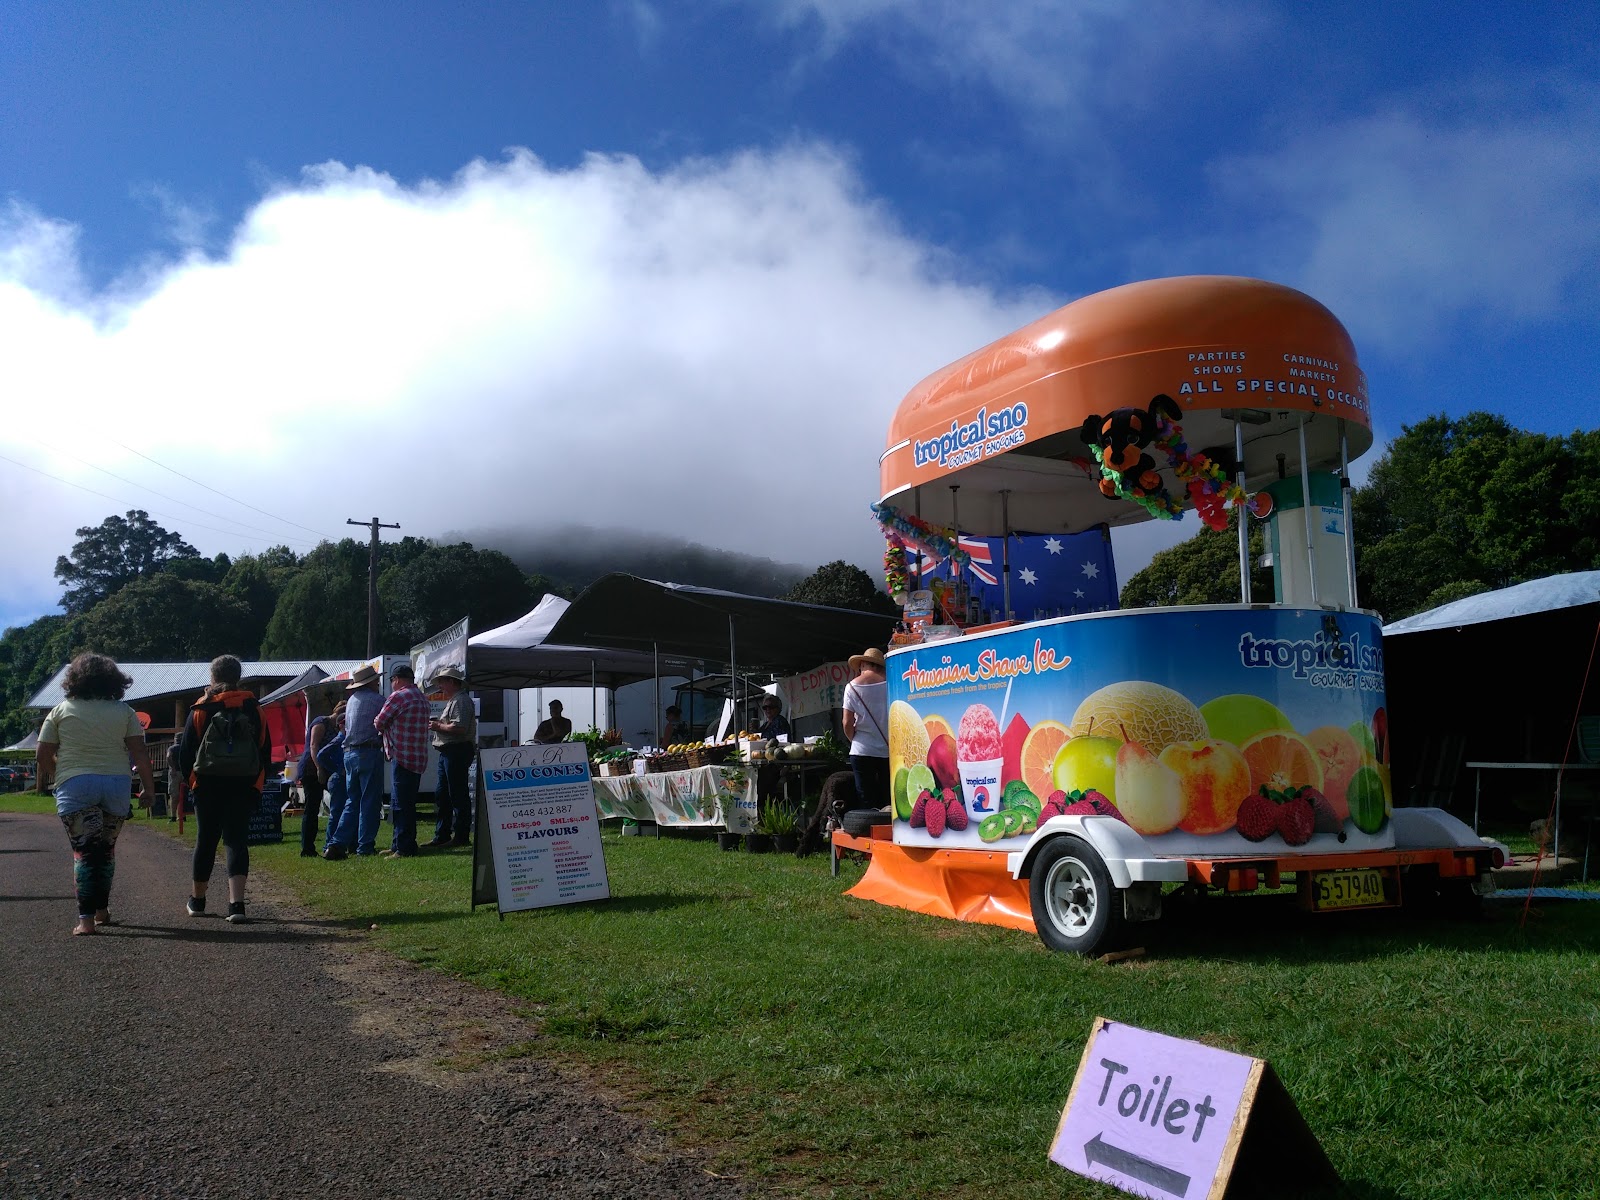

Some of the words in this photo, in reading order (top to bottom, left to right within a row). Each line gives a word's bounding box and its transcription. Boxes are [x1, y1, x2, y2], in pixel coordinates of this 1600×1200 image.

[1188, 351, 1246, 362] PARTIES
[1283, 353, 1339, 371] CARNIVALS
[1193, 365, 1243, 375] SHOWS
[1289, 367, 1336, 384] MARKETS
[1179, 380, 1223, 394] ALL
[1236, 380, 1319, 397] SPECIAL
[914, 406, 987, 467] tropical
[987, 401, 1028, 438] sno
[948, 445, 983, 469] GOURMET
[985, 429, 1025, 456] SNOCONES
[1239, 632, 1360, 679] tropical
[902, 655, 978, 692] Hawaiian
[978, 649, 1032, 680] Shave
[1033, 638, 1072, 675] Ice
[951, 686, 964, 694] fresh
[964, 684, 977, 693] from
[978, 683, 987, 691] the
[987, 681, 1007, 691] tropics
[1310, 672, 1357, 689] GOURMET
[500, 749, 528, 768] R
[543, 745, 569, 765] R
[492, 769, 526, 782] SNO
[531, 764, 584, 778] CONES
[966, 777, 986, 787] tropical
[512, 808, 535, 818] 0448
[538, 806, 554, 816] 432
[556, 804, 572, 814] 887
[733, 797, 758, 809] Trees
[517, 826, 579, 841] FLAVOURS
[564, 854, 593, 862] RASPBERRY
[556, 872, 590, 880] PASSIONFRUIT
[1341, 898, 1359, 906] SOUTH
[1361, 896, 1378, 904] WALES
[1098, 1057, 1217, 1143] Toilet
